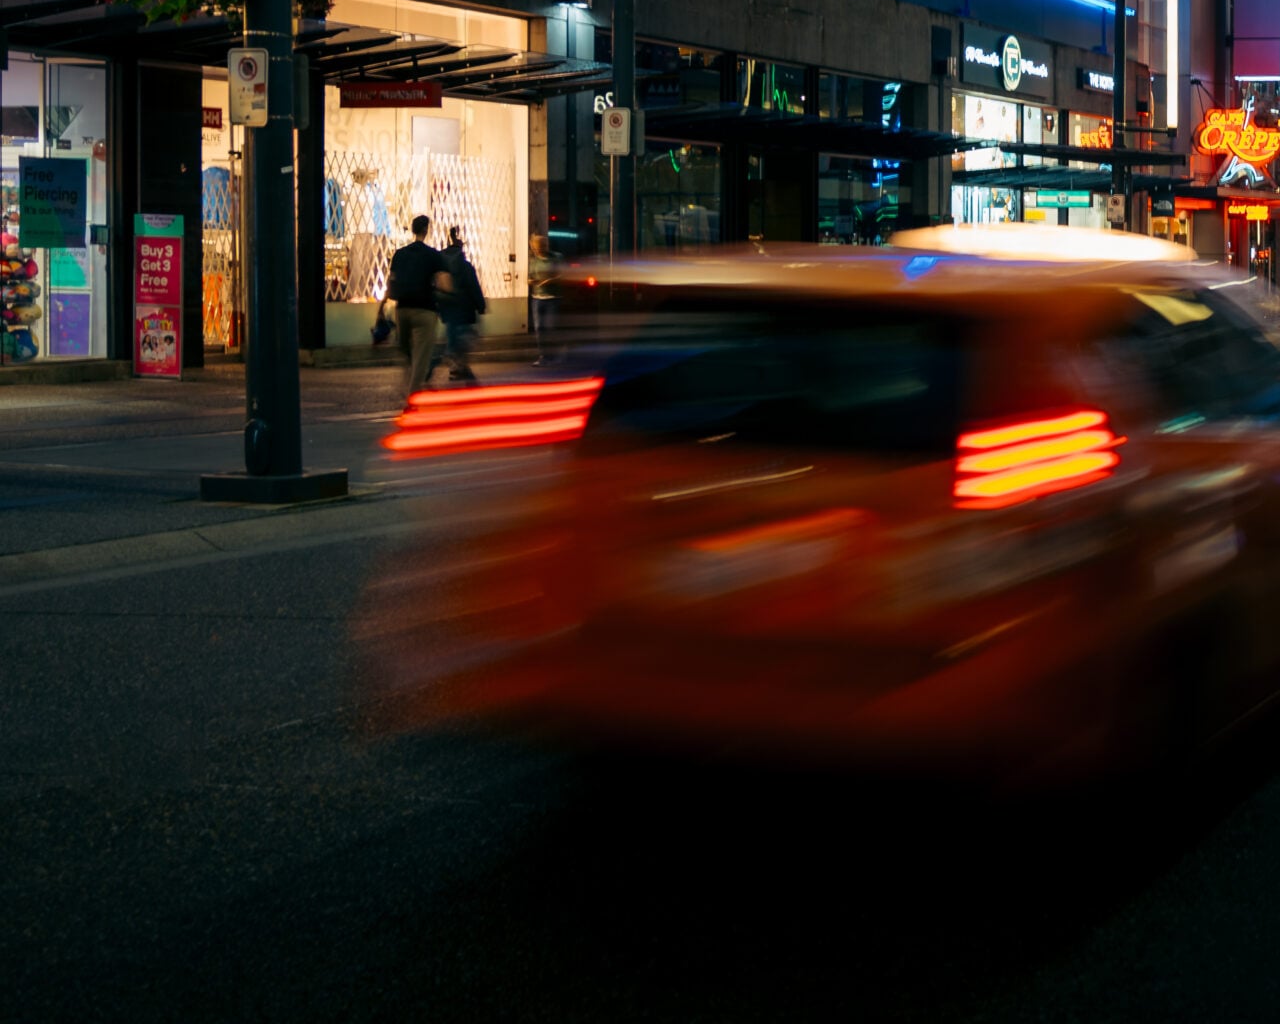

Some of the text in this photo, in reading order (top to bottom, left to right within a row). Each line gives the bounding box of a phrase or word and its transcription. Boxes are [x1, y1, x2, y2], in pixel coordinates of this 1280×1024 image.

[24, 166, 55, 183] Free
[24, 185, 78, 205] Piercing
[140, 243, 174, 259] Buy 3
[140, 258, 171, 273] Get 3
[140, 273, 169, 287] Free
